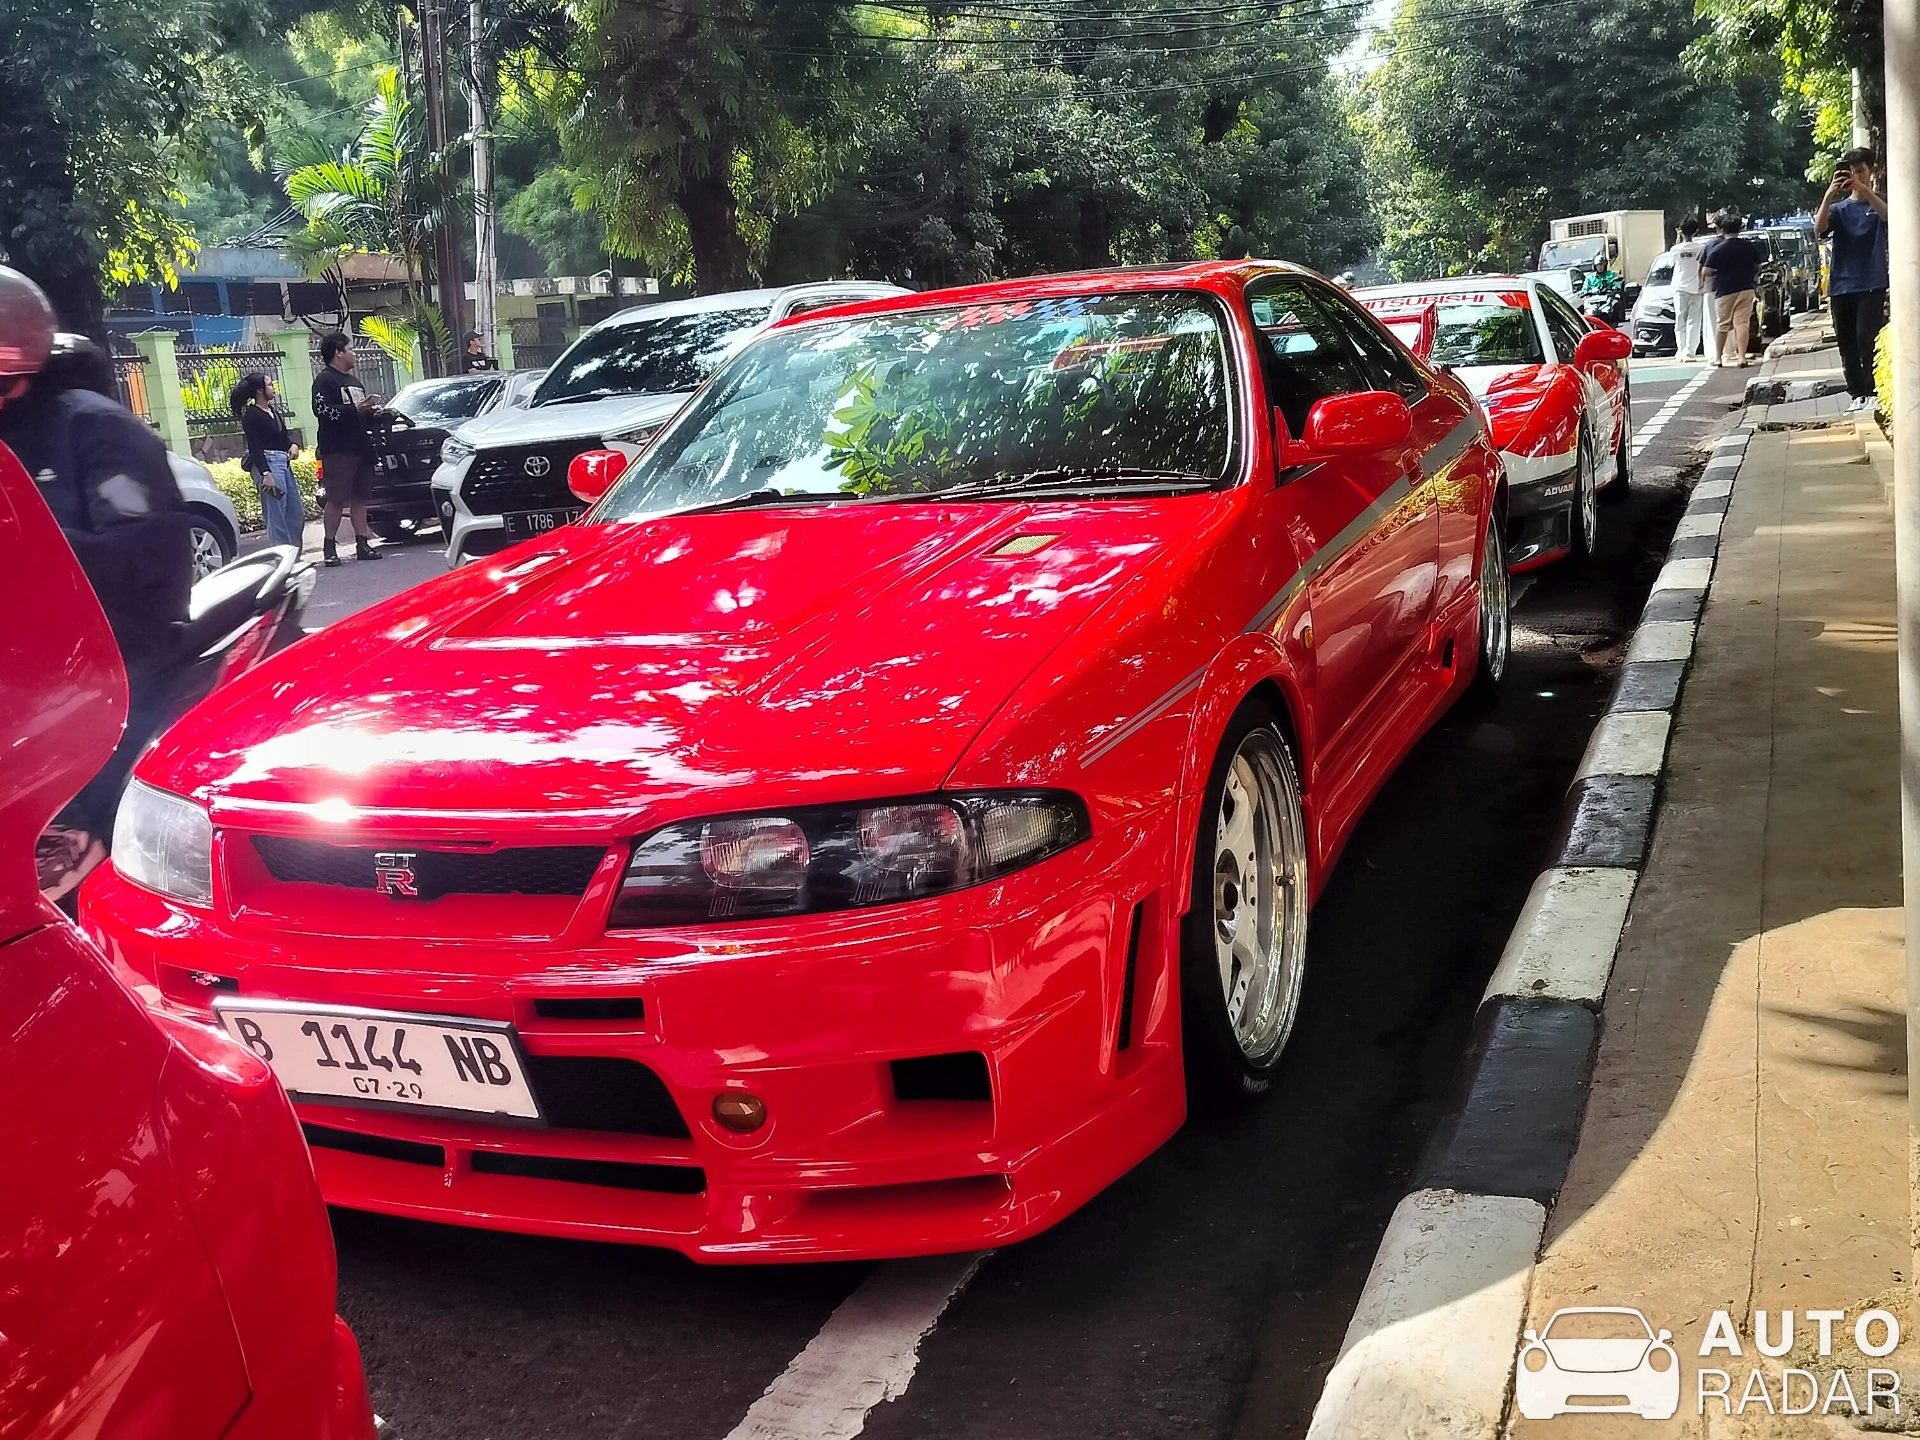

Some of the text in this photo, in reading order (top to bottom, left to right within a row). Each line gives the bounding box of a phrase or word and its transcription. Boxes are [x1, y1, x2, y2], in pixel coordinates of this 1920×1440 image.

[1543, 482, 1574, 497] ADVAN
[506, 517, 516, 533] E
[526, 513, 555, 531] 1786
[373, 852, 417, 868] GT
[375, 867, 418, 896] R
[234, 1017, 512, 1086] B 1144 NB
